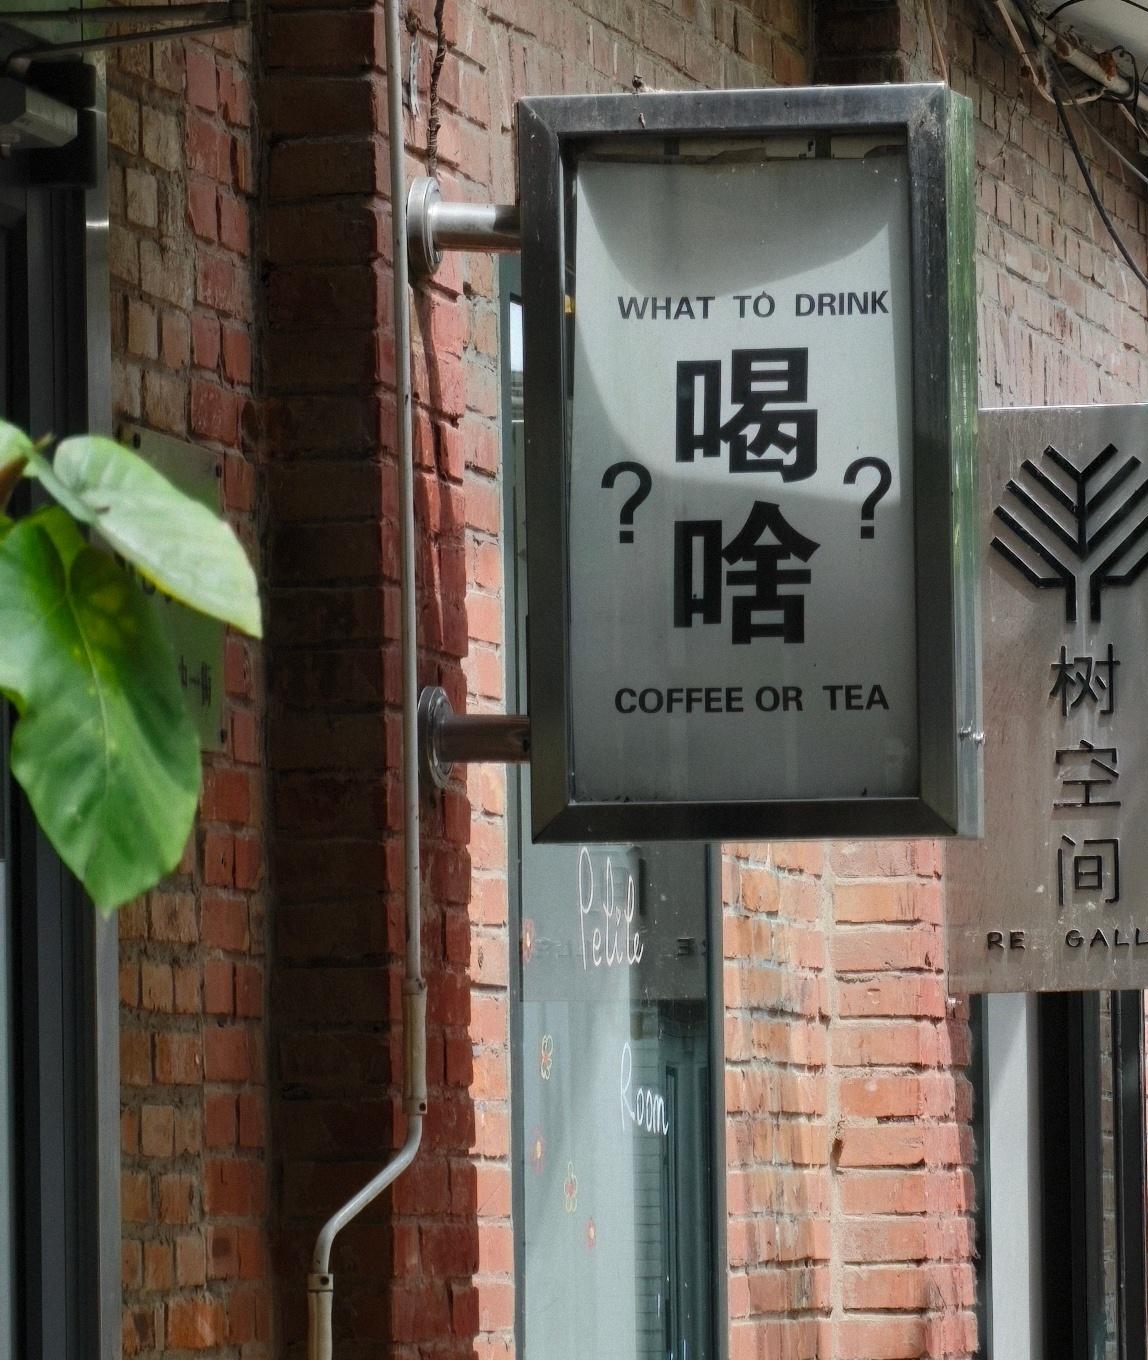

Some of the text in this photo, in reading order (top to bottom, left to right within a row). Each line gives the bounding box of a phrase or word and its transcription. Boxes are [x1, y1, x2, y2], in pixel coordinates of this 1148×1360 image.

[617, 290, 890, 320] WHAT TO DRINK
[601, 461, 652, 544] ?
[673, 347, 821, 645] 喝啥
[843, 456, 893, 540] ?
[614, 684, 890, 715] COFFEE OR TEA
[1049, 643, 1122, 908] 树空间
[620, 1042, 669, 1136] Room
